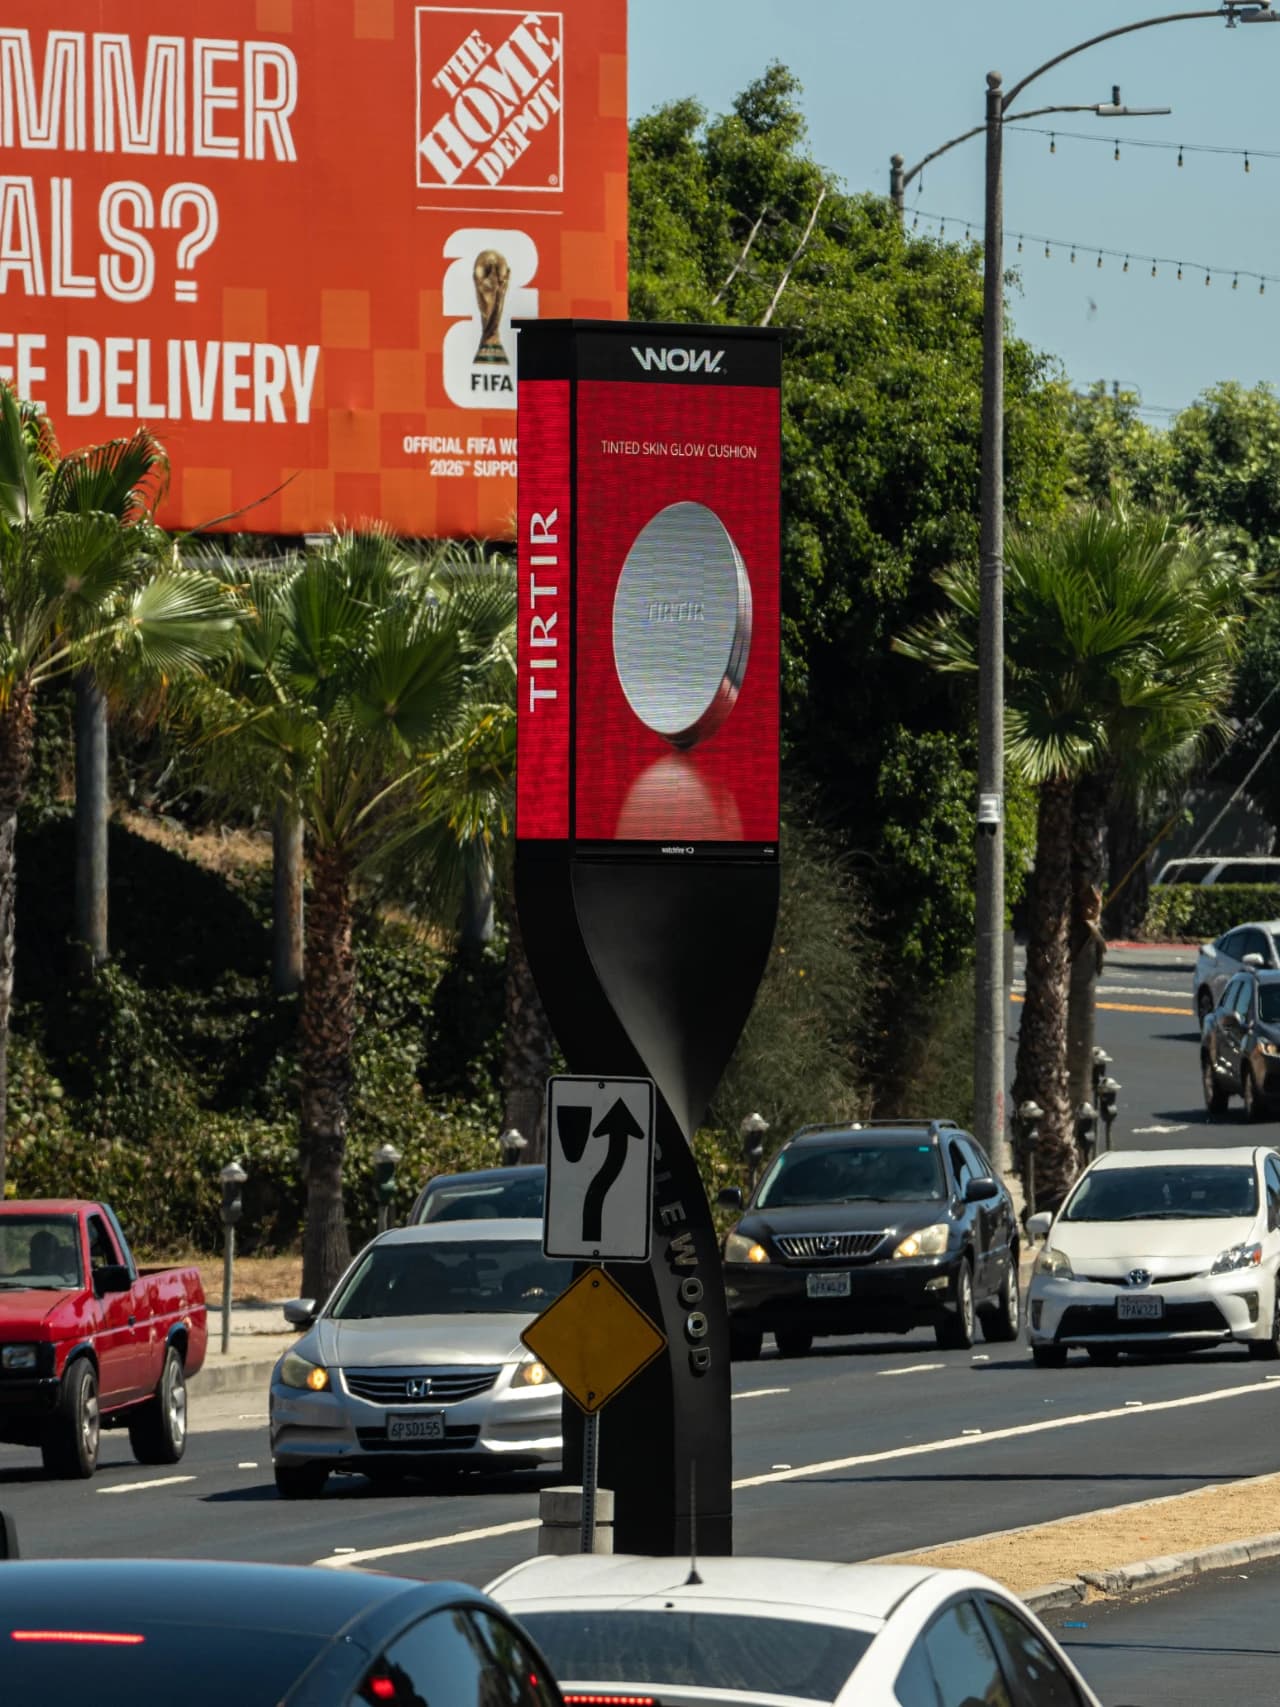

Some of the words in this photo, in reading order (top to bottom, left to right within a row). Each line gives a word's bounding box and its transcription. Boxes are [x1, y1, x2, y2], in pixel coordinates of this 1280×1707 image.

[0, 27, 298, 163] MMER
[419, 12, 563, 186] HOME
[432, 28, 498, 99] THE
[472, 79, 562, 187] DEPOT
[0, 175, 219, 303] ALS?
[66, 335, 321, 425] DELIVERY
[471, 373, 514, 392] FIFA
[403, 435, 465, 454] OFFICIAL
[467, 436, 497, 455] FIFA
[600, 440, 640, 455] TINTED
[642, 442, 668, 456] SKIN
[670, 443, 705, 457] GLOW
[707, 444, 757, 459] CUSHION
[530, 507, 558, 713] TIRTIR
